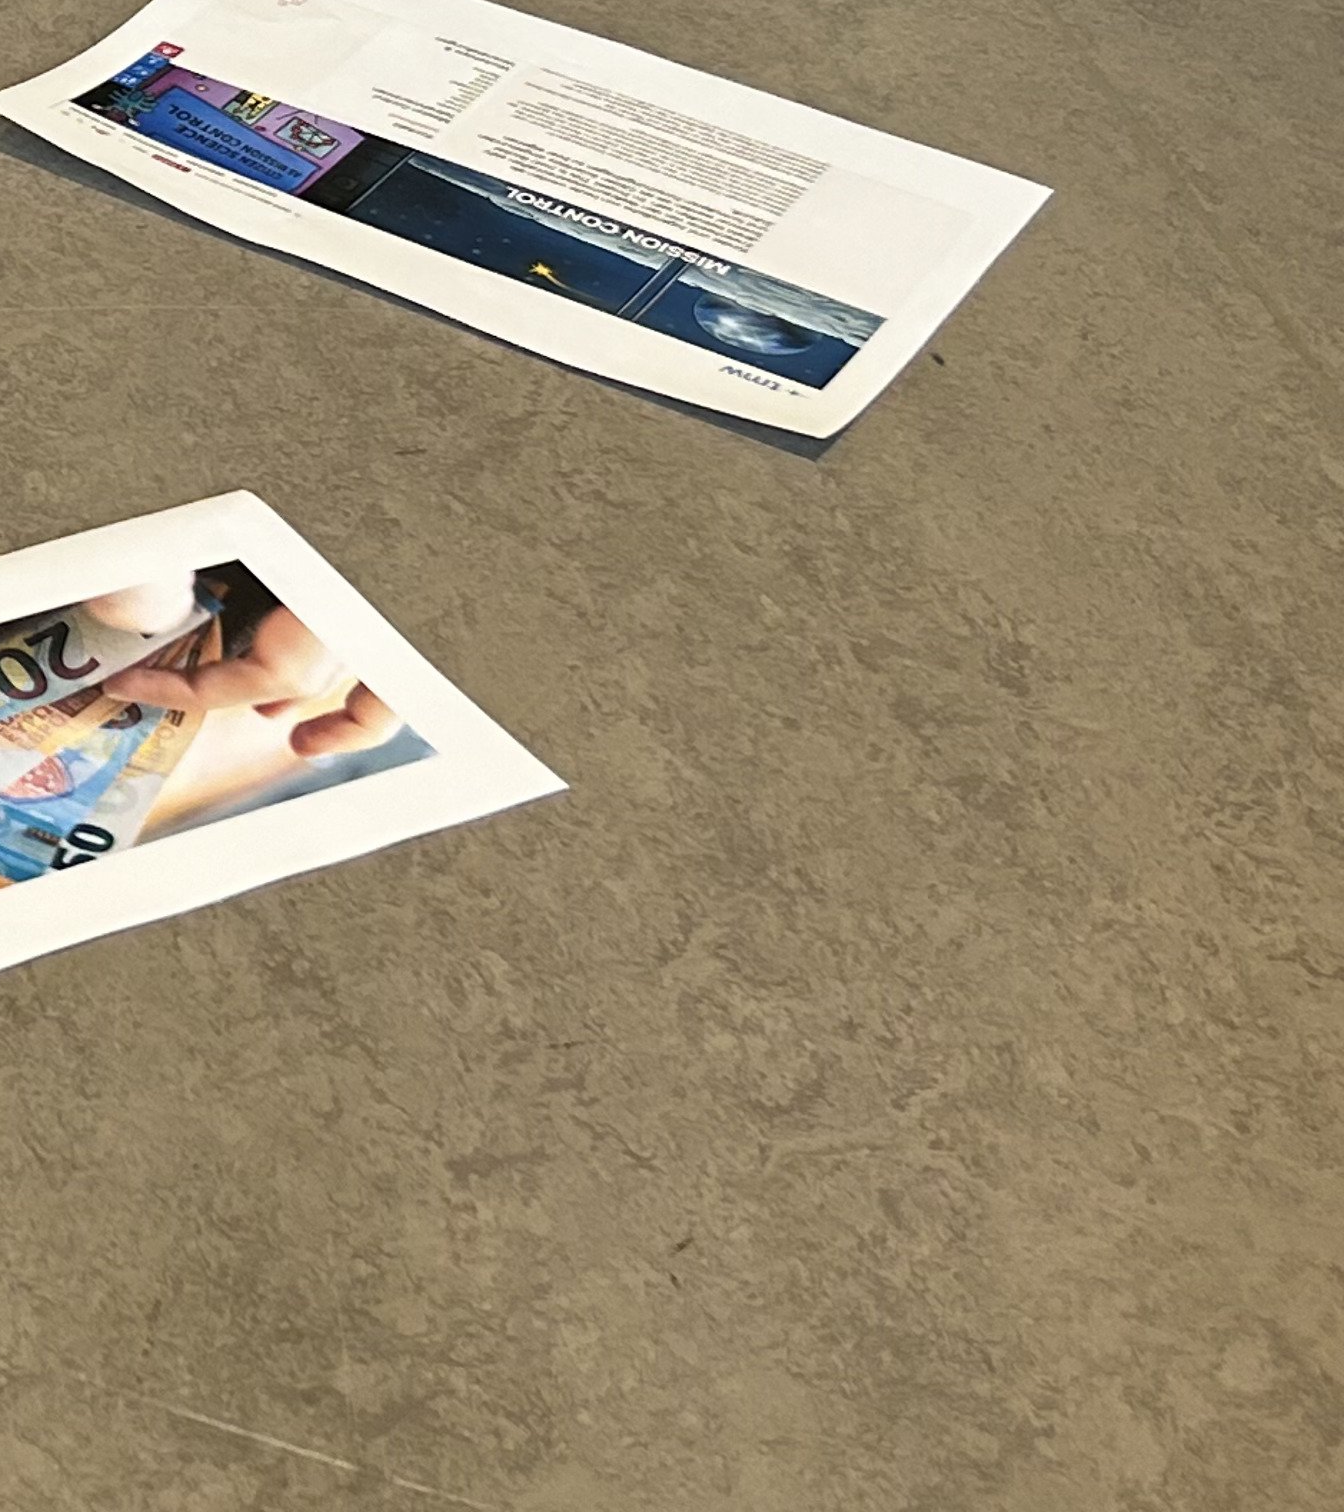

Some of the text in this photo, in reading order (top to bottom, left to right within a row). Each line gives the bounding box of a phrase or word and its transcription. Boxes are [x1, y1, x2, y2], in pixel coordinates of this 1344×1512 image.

[167, 102, 243, 149] CONTROL
[173, 123, 238, 159] SCIENCE
[238, 155, 284, 181] CITIZEN
[240, 143, 290, 174] MISSION
[288, 168, 304, 179] AS
[503, 185, 621, 236] CONTROL
[620, 228, 733, 276] MISSION
[717, 365, 782, 392] tmw
